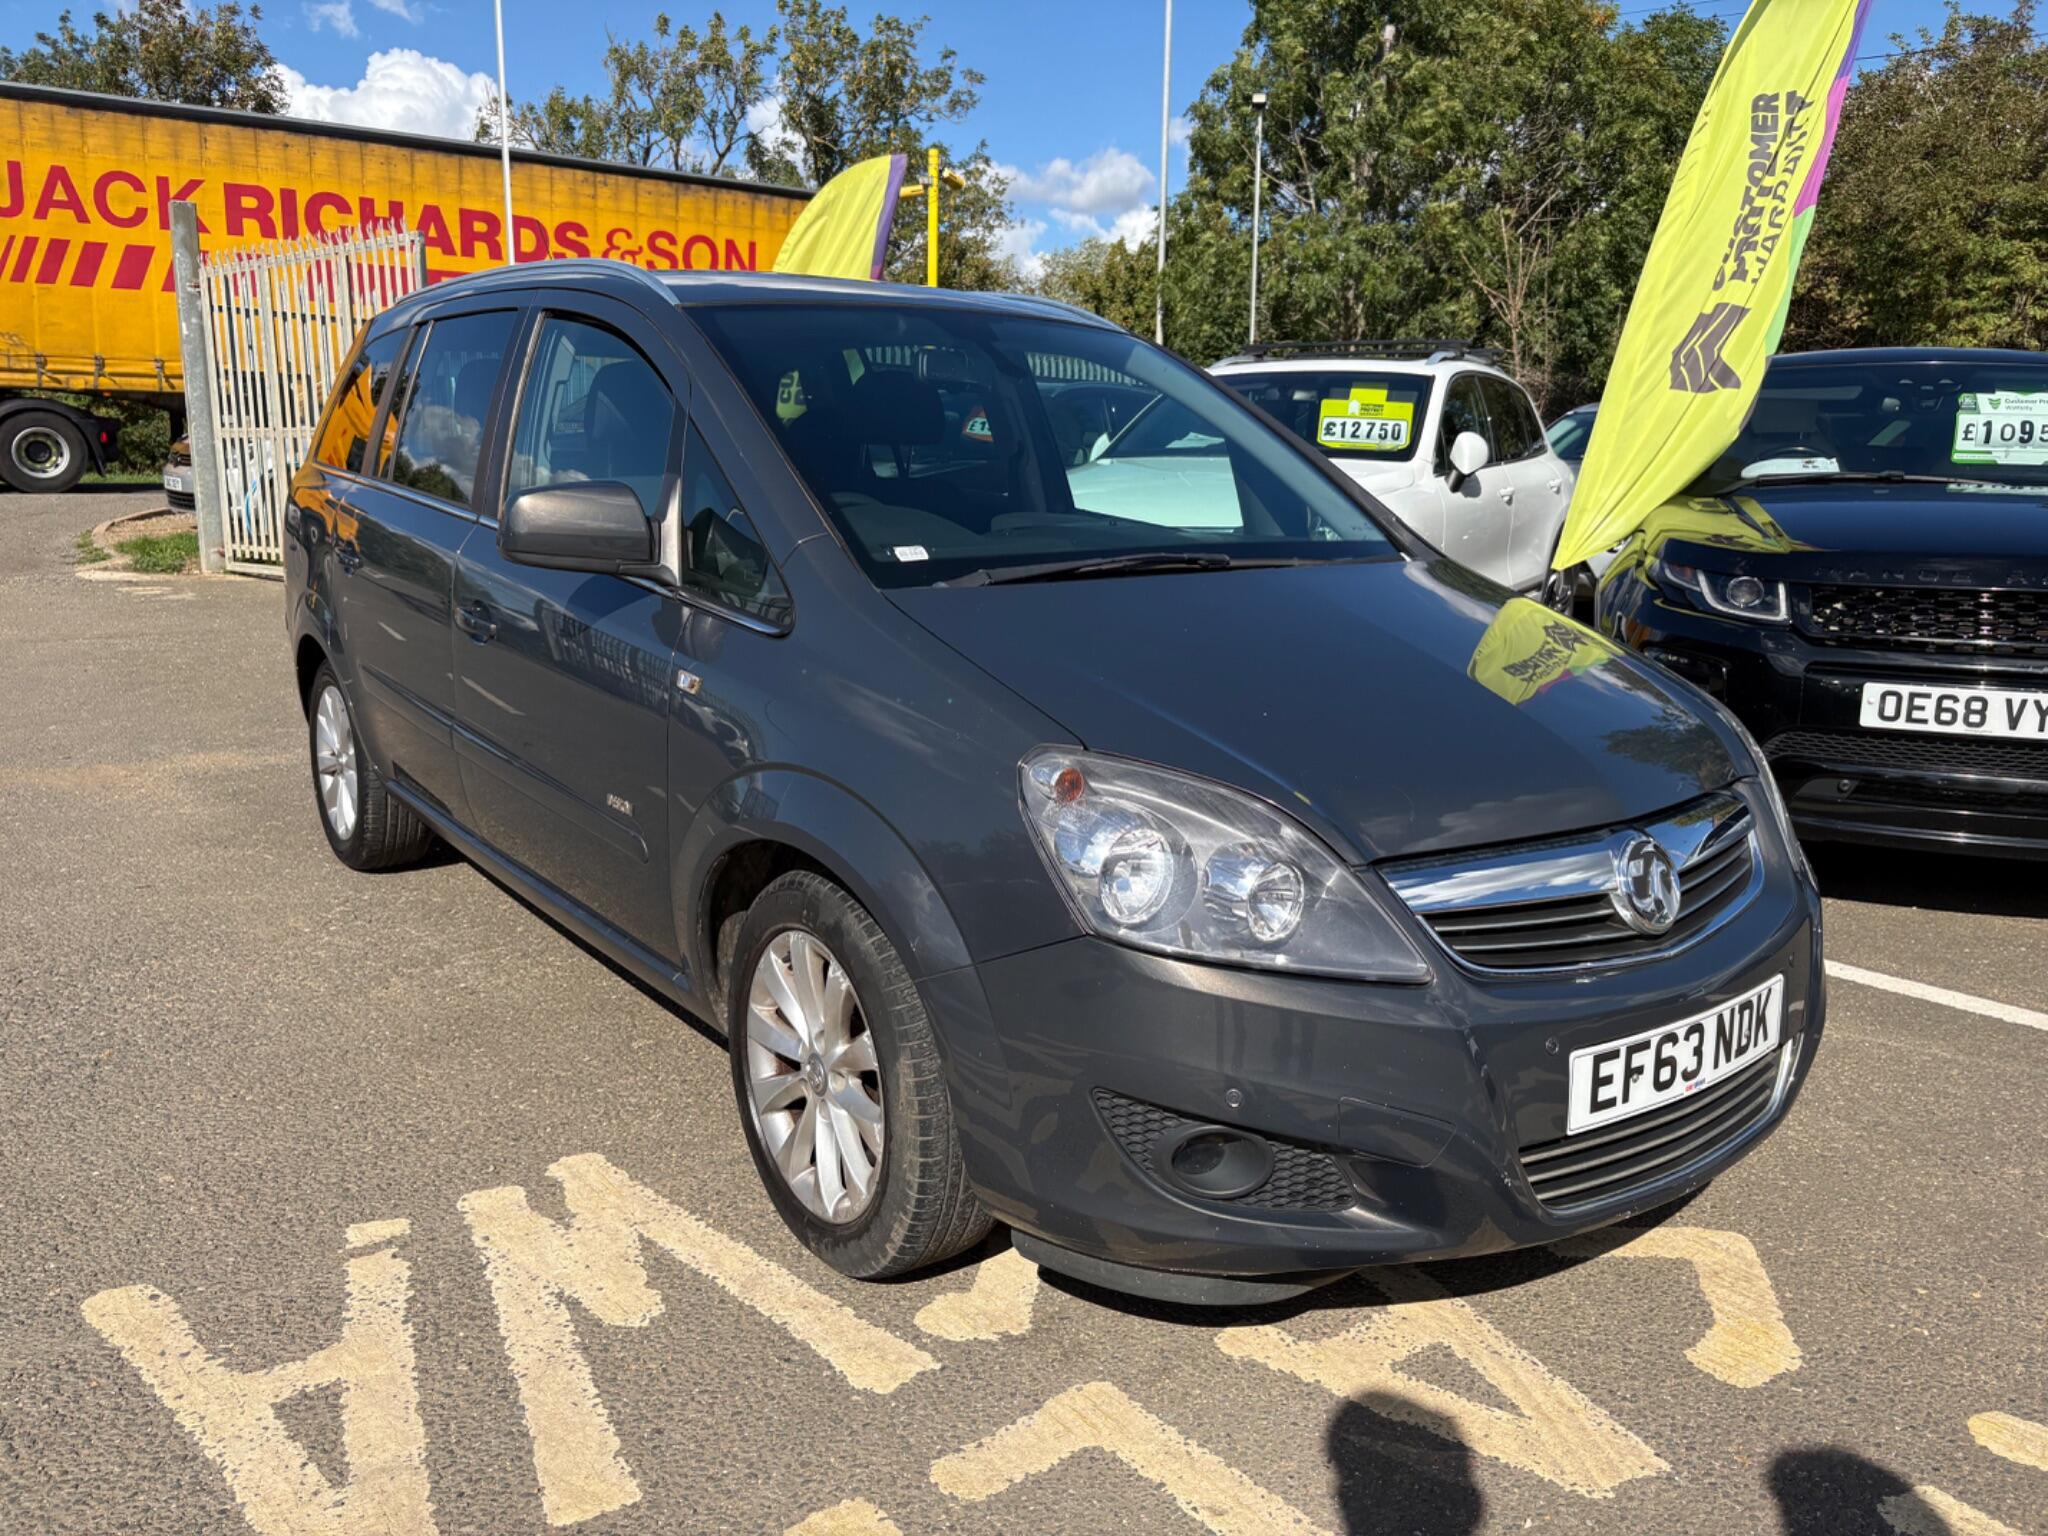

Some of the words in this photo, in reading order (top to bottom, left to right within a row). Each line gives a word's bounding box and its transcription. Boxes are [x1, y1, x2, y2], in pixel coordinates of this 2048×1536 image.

[0, 160, 212, 234] JACK
[223, 181, 591, 263] RICHARDS
[1324, 420, 1402, 441] £12750
[1878, 690, 1988, 728] OE68
[1590, 1022, 1705, 1114] EF63
[1713, 987, 1772, 1071] NDK
